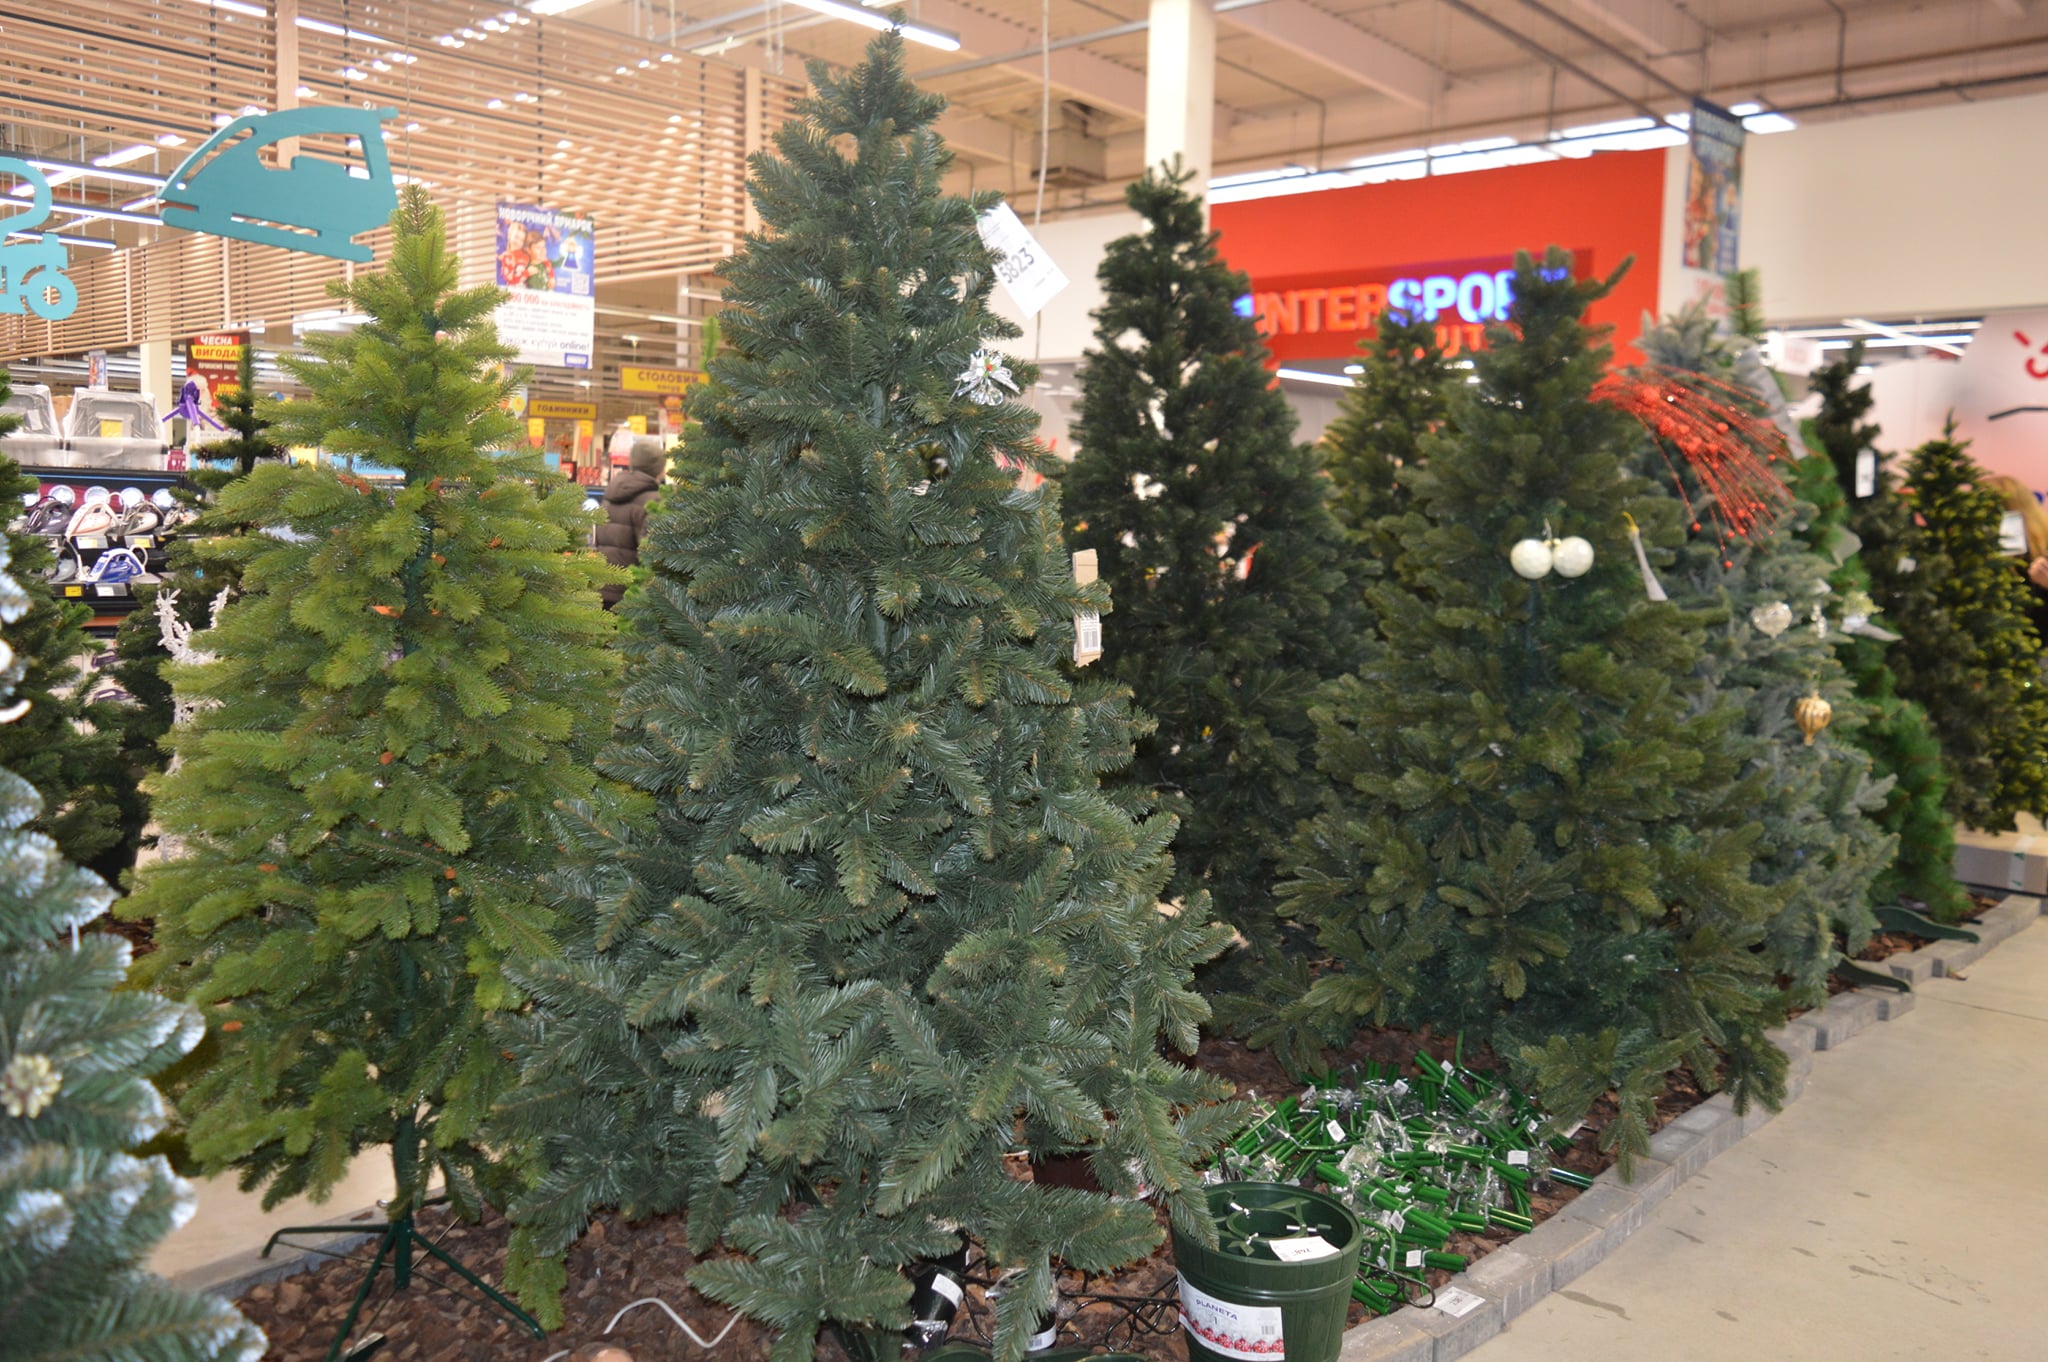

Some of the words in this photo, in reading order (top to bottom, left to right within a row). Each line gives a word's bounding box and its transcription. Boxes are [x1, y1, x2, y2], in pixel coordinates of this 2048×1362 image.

[998, 246, 1035, 284] 5823
[1253, 267, 1568, 336] INTERSPO
[200, 335, 233, 346] ЧЕСНА
[537, 404, 590, 415] ГОДИННИКИ
[1196, 1299, 1238, 1321] PLANETA
